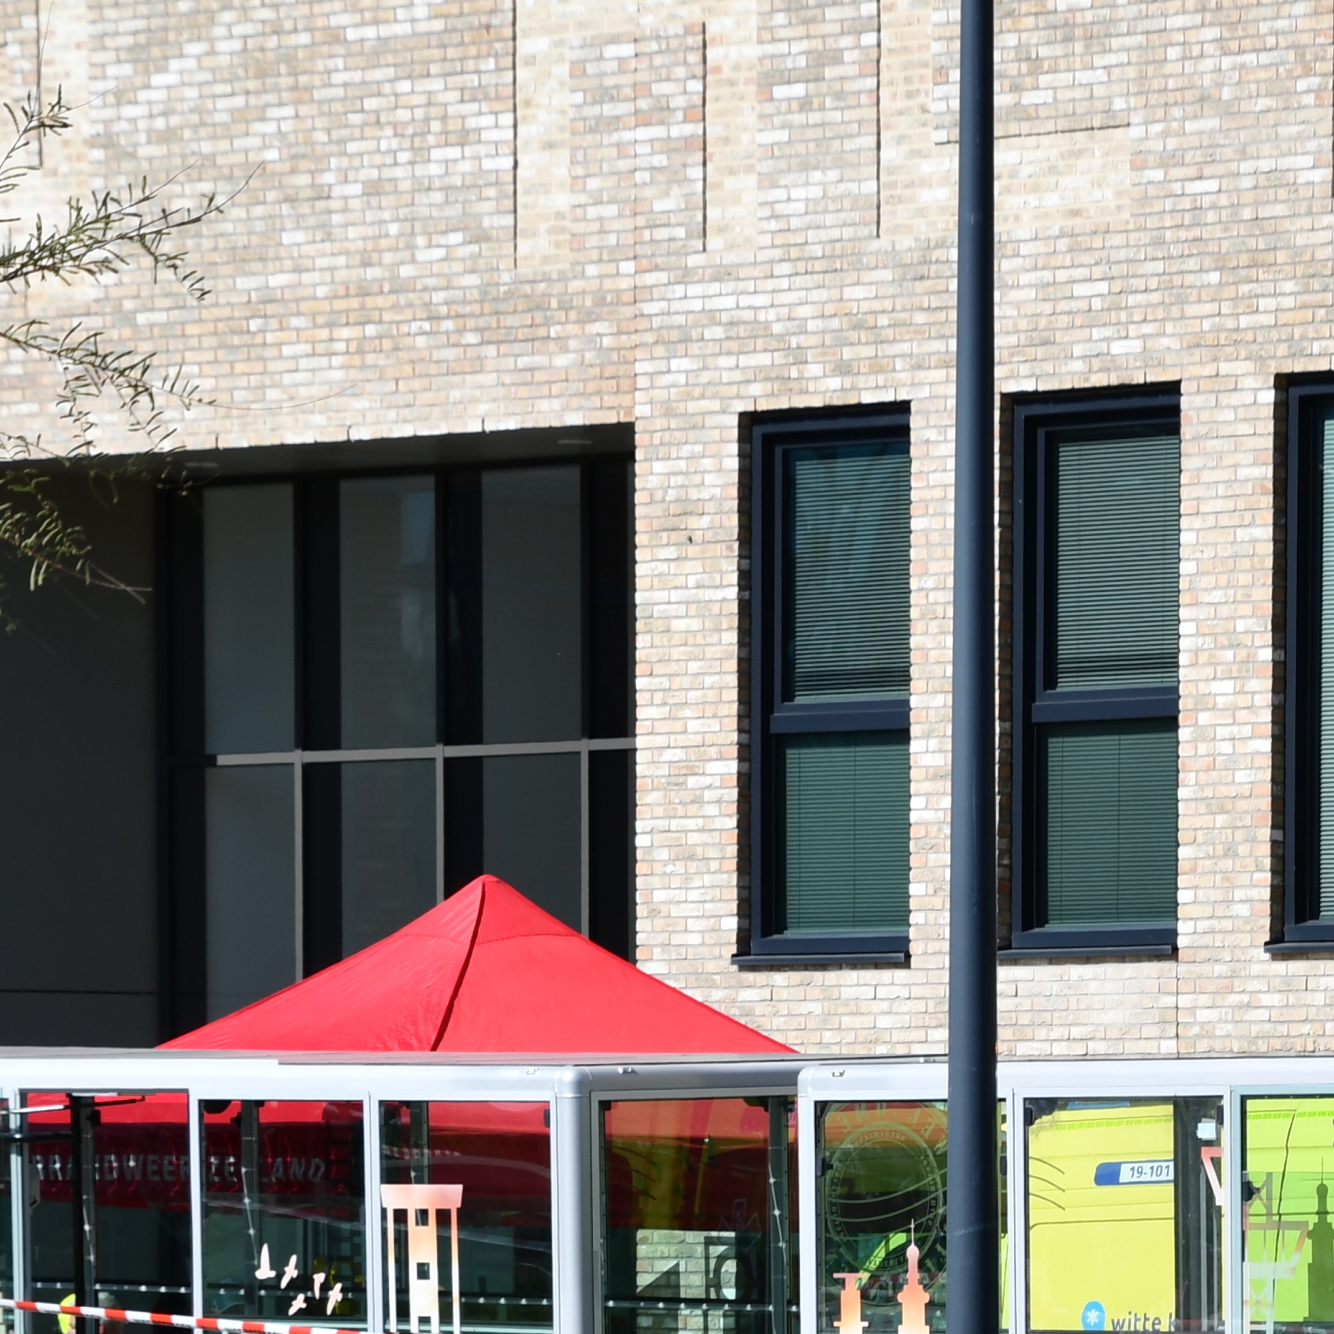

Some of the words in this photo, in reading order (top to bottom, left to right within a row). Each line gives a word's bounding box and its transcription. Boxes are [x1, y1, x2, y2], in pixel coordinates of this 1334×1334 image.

[31, 1154, 190, 1182] BRDWEER
[209, 1155, 326, 1183] ZEAND
[1129, 1164, 1171, 1179] 19-101
[1111, 1311, 1162, 1332] witte
